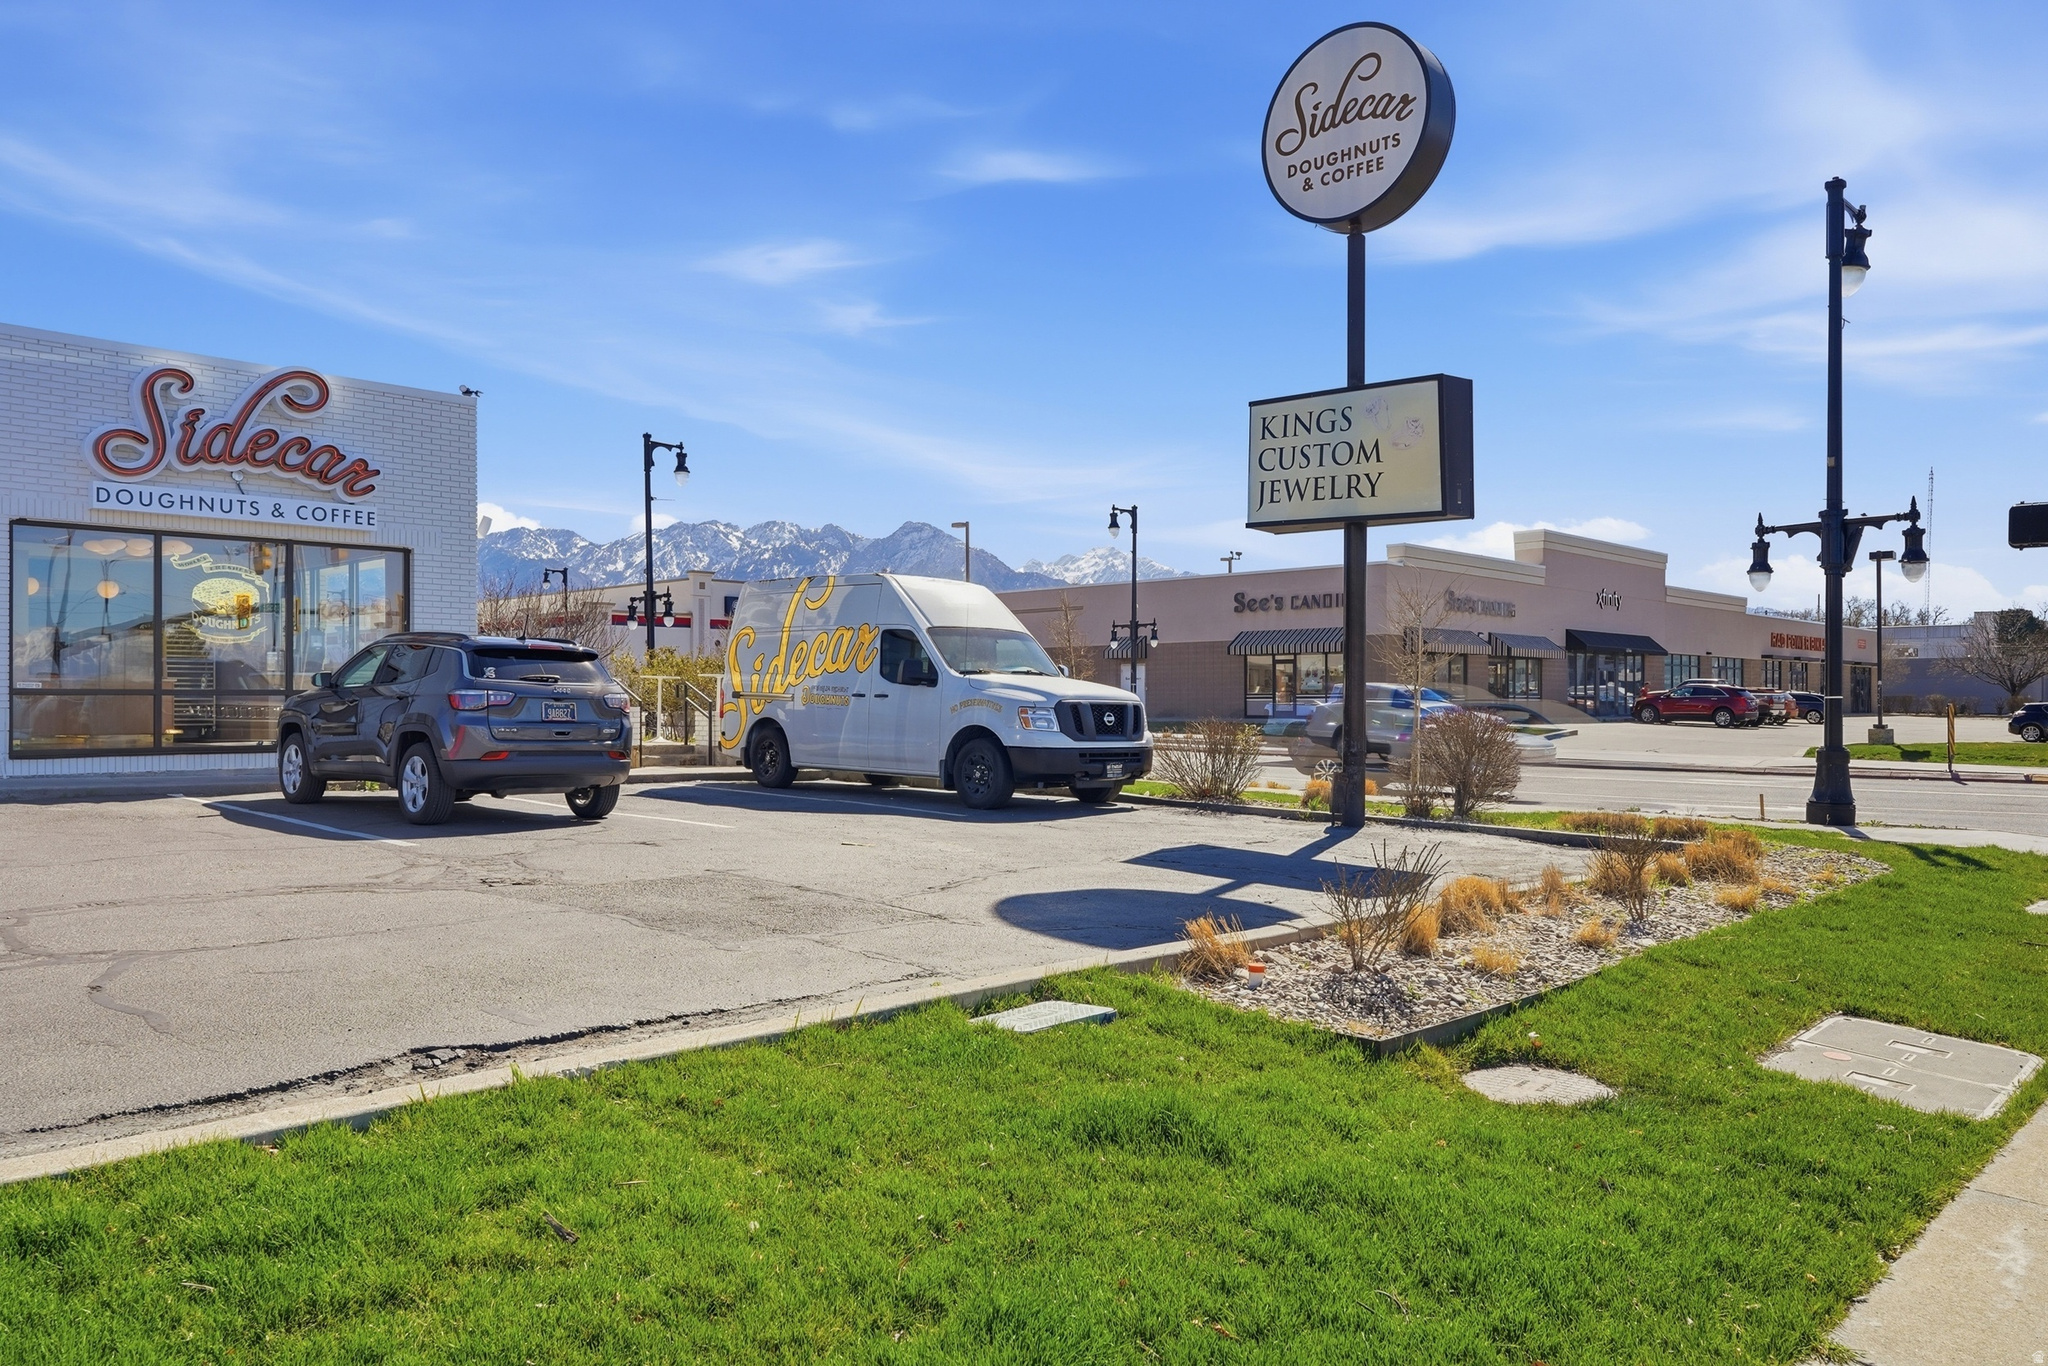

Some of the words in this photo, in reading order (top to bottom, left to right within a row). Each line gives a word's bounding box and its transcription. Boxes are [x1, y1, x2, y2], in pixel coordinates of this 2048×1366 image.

[1274, 52, 1417, 157] Sidecar
[1287, 132, 1401, 179] DOUGHNUTS
[1302, 176, 1314, 192] &
[1320, 156, 1385, 187] COFFEE
[92, 367, 381, 499] Sidecar
[1259, 405, 1353, 441] KINGS
[1257, 437, 1385, 473] CUSTOM
[96, 486, 260, 516] DOUGHNUTS
[271, 502, 286, 519] &
[295, 504, 377, 527] COFFEE
[1255, 471, 1385, 513] JEWELRY
[1233, 592, 1285, 614] See's
[720, 575, 880, 750] Sidecar
